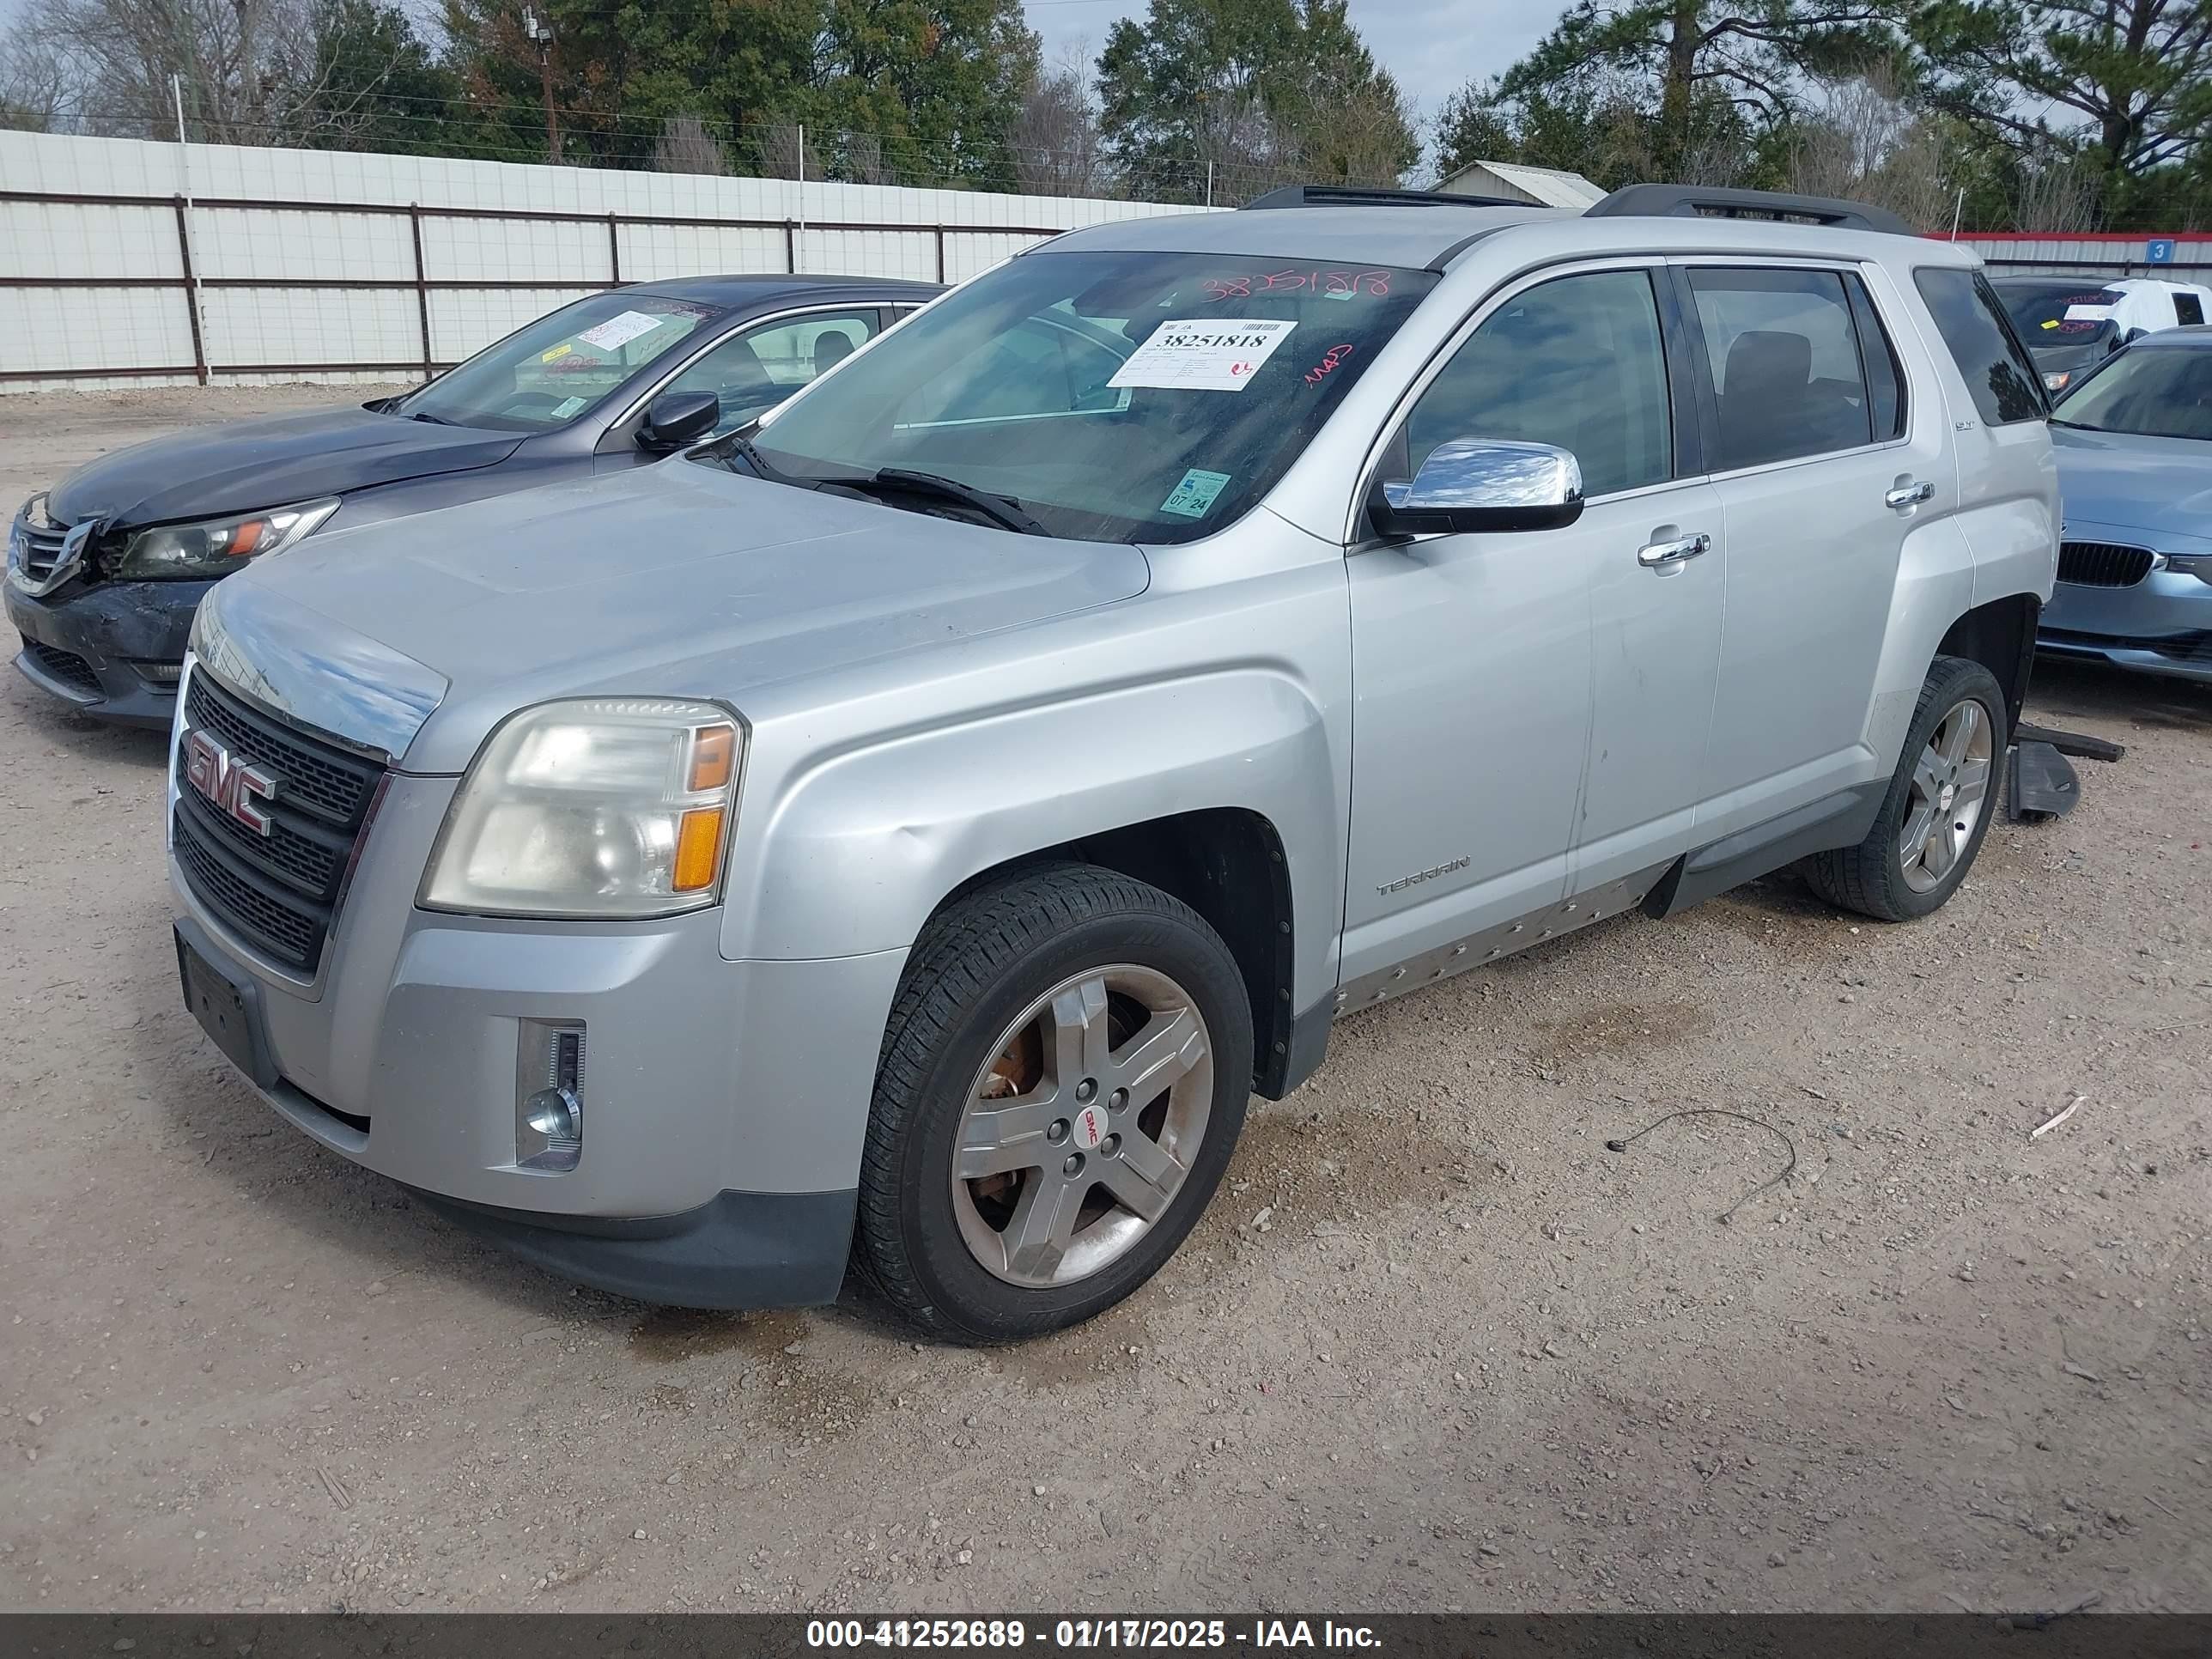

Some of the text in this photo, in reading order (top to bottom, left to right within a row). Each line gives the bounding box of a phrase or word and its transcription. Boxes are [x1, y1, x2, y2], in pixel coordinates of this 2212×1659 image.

[2154, 244, 2165, 259] 3
[1156, 334, 1267, 348] 38251818
[1170, 495, 1208, 510] 07 24
[187, 731, 276, 837] GMC
[1376, 854, 1471, 896] TERRAIN
[1085, 1110, 1098, 1146] GMC
